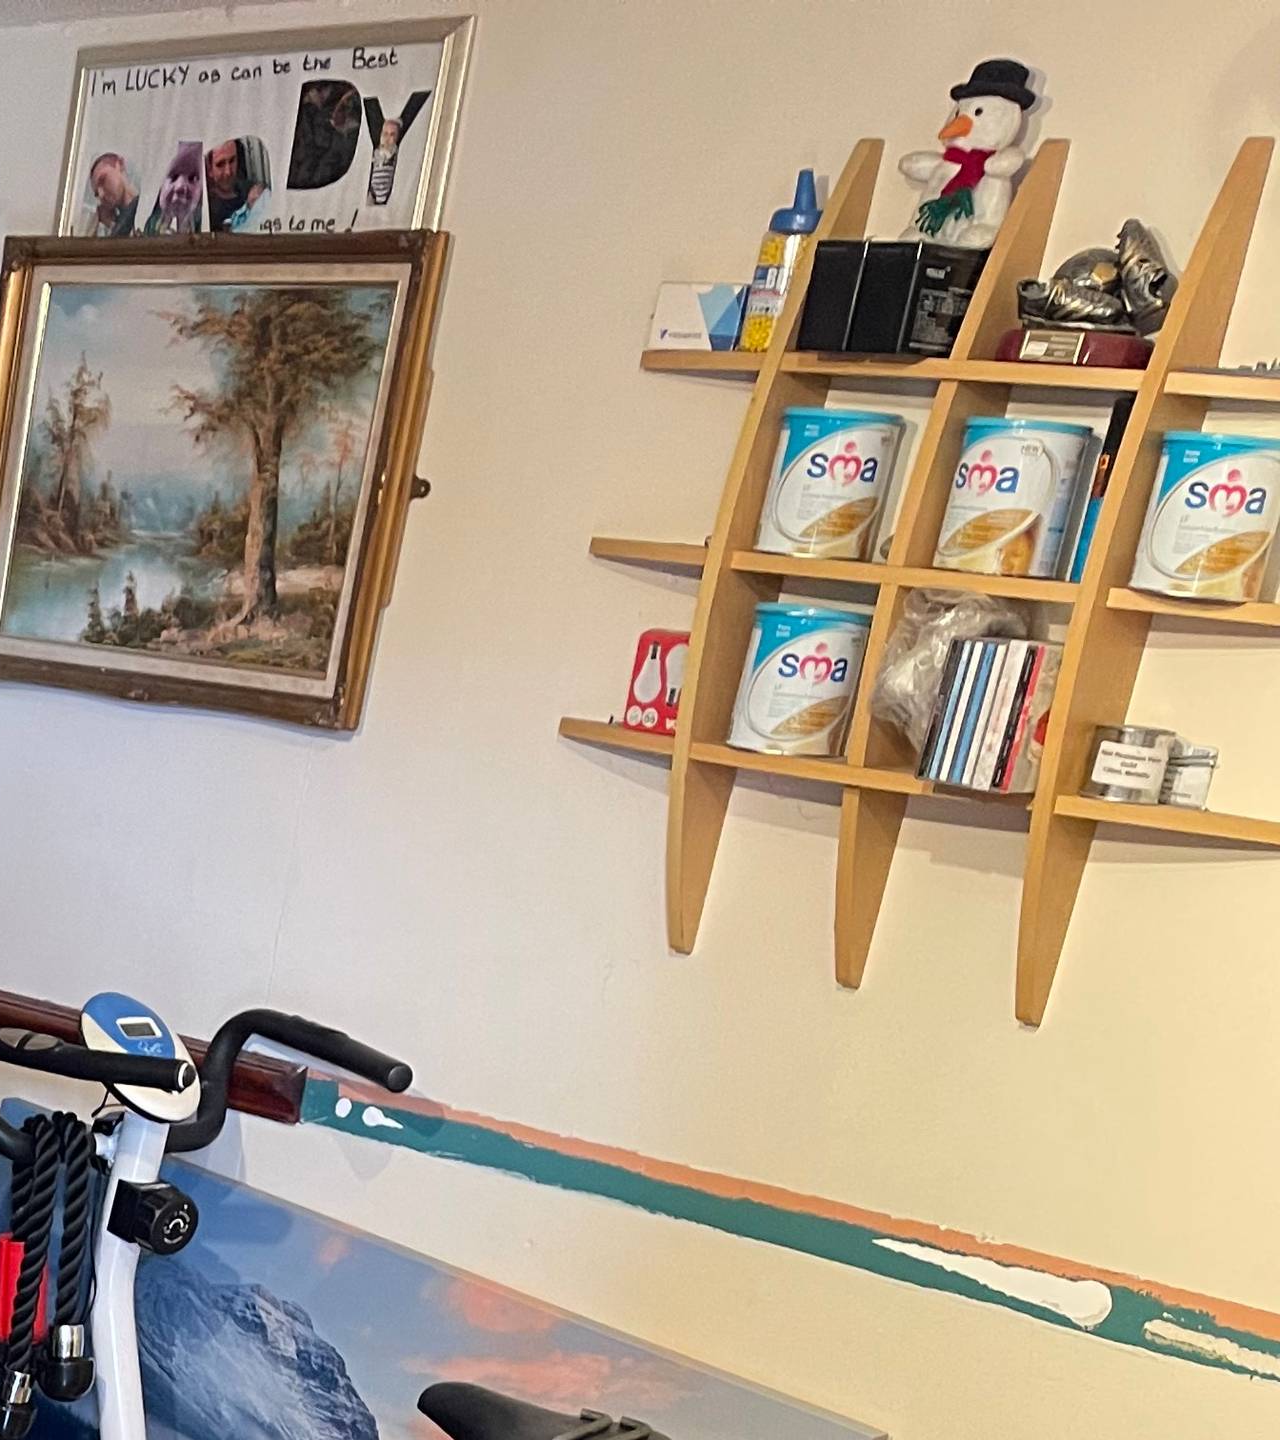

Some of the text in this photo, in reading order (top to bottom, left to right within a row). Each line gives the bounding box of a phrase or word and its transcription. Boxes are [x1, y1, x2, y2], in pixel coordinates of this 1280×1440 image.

[91, 46, 400, 97] I'm LUCKY as can be the Best
[289, 213, 306, 232] to
[311, 216, 337, 234] me
[806, 441, 879, 487] sma
[955, 450, 1021, 497] sma
[1184, 469, 1267, 518] sma
[778, 642, 849, 687] sma
